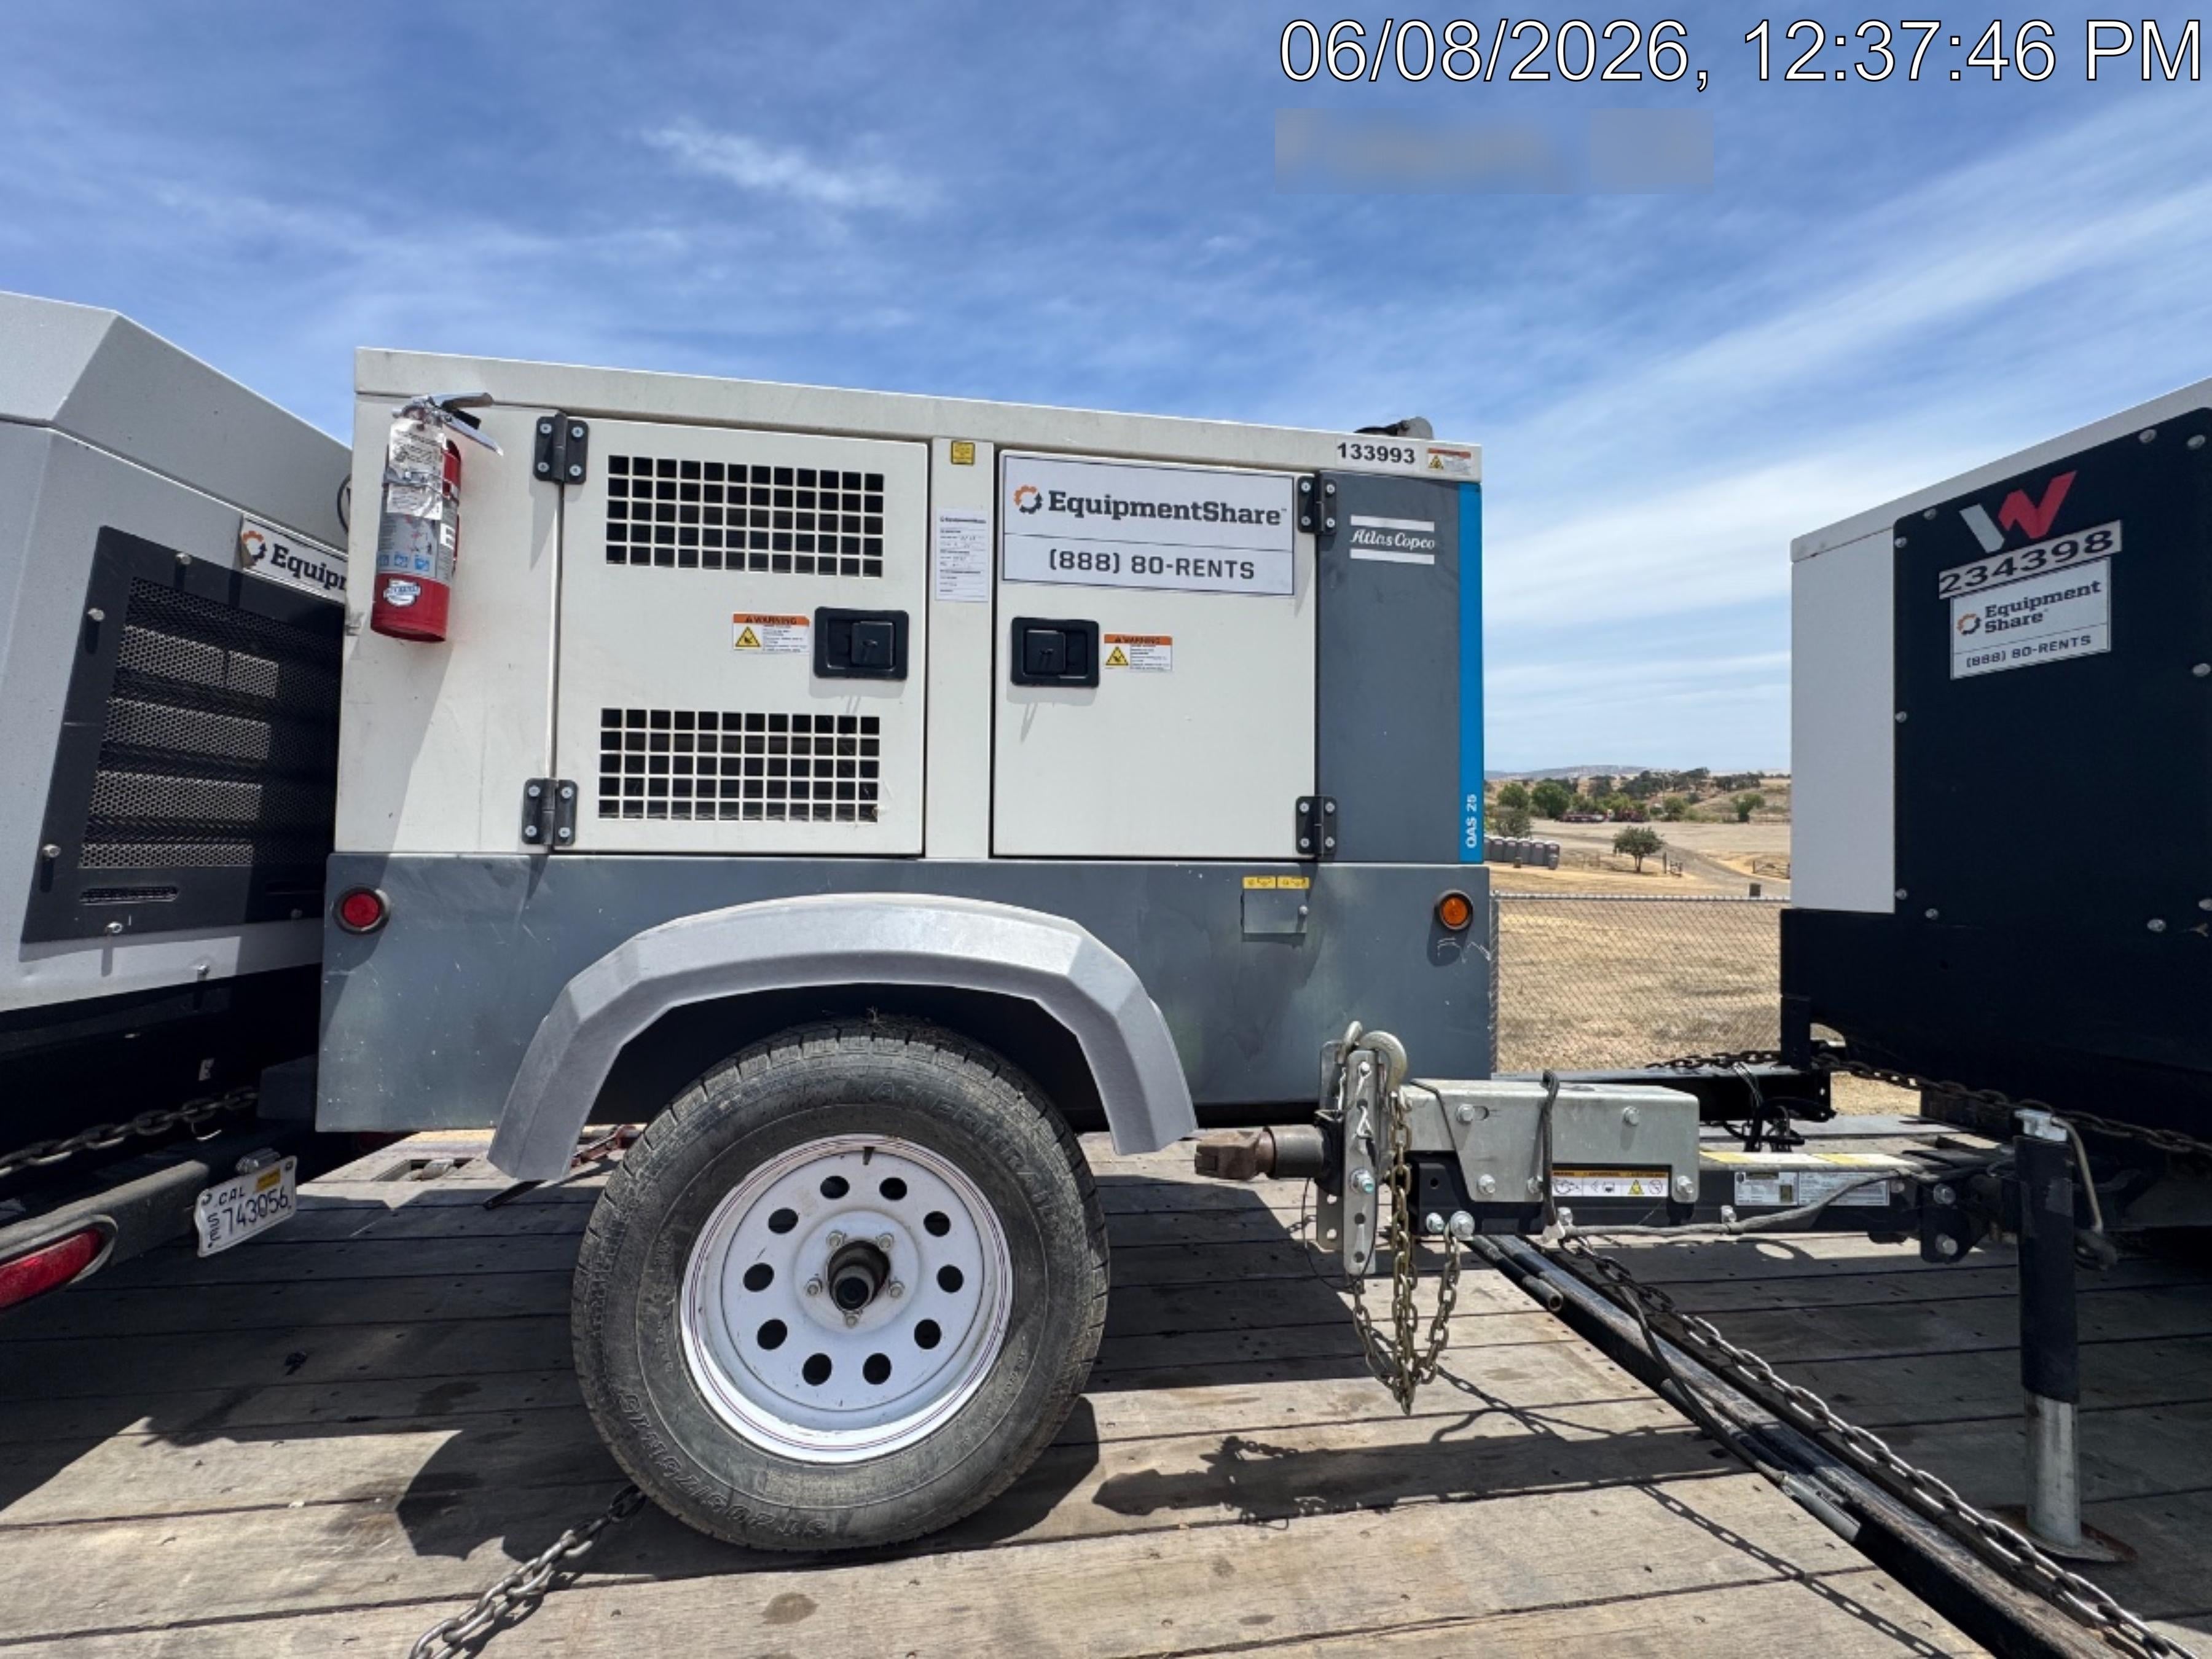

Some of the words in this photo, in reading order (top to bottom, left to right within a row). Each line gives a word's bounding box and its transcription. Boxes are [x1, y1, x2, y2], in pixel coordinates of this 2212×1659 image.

[1337, 442, 1416, 465] 133993
[1048, 490, 1281, 526] EquipmentShare
[1350, 528, 1392, 546] Atlas
[1395, 531, 1435, 551] Copco
[1049, 549, 1120, 574] (888)
[1131, 555, 1255, 579] 80-RENTS
[1939, 530, 2114, 595] 234398
[1985, 580, 2101, 619] Equipment
[753, 616, 798, 625] WARNING
[1985, 612, 2044, 634] Share
[1966, 649, 2006, 668] (888)
[2012, 635, 2092, 659] 80-RENTS
[219, 1186, 246, 1206] CAL
[222, 1186, 288, 1235] 743056
